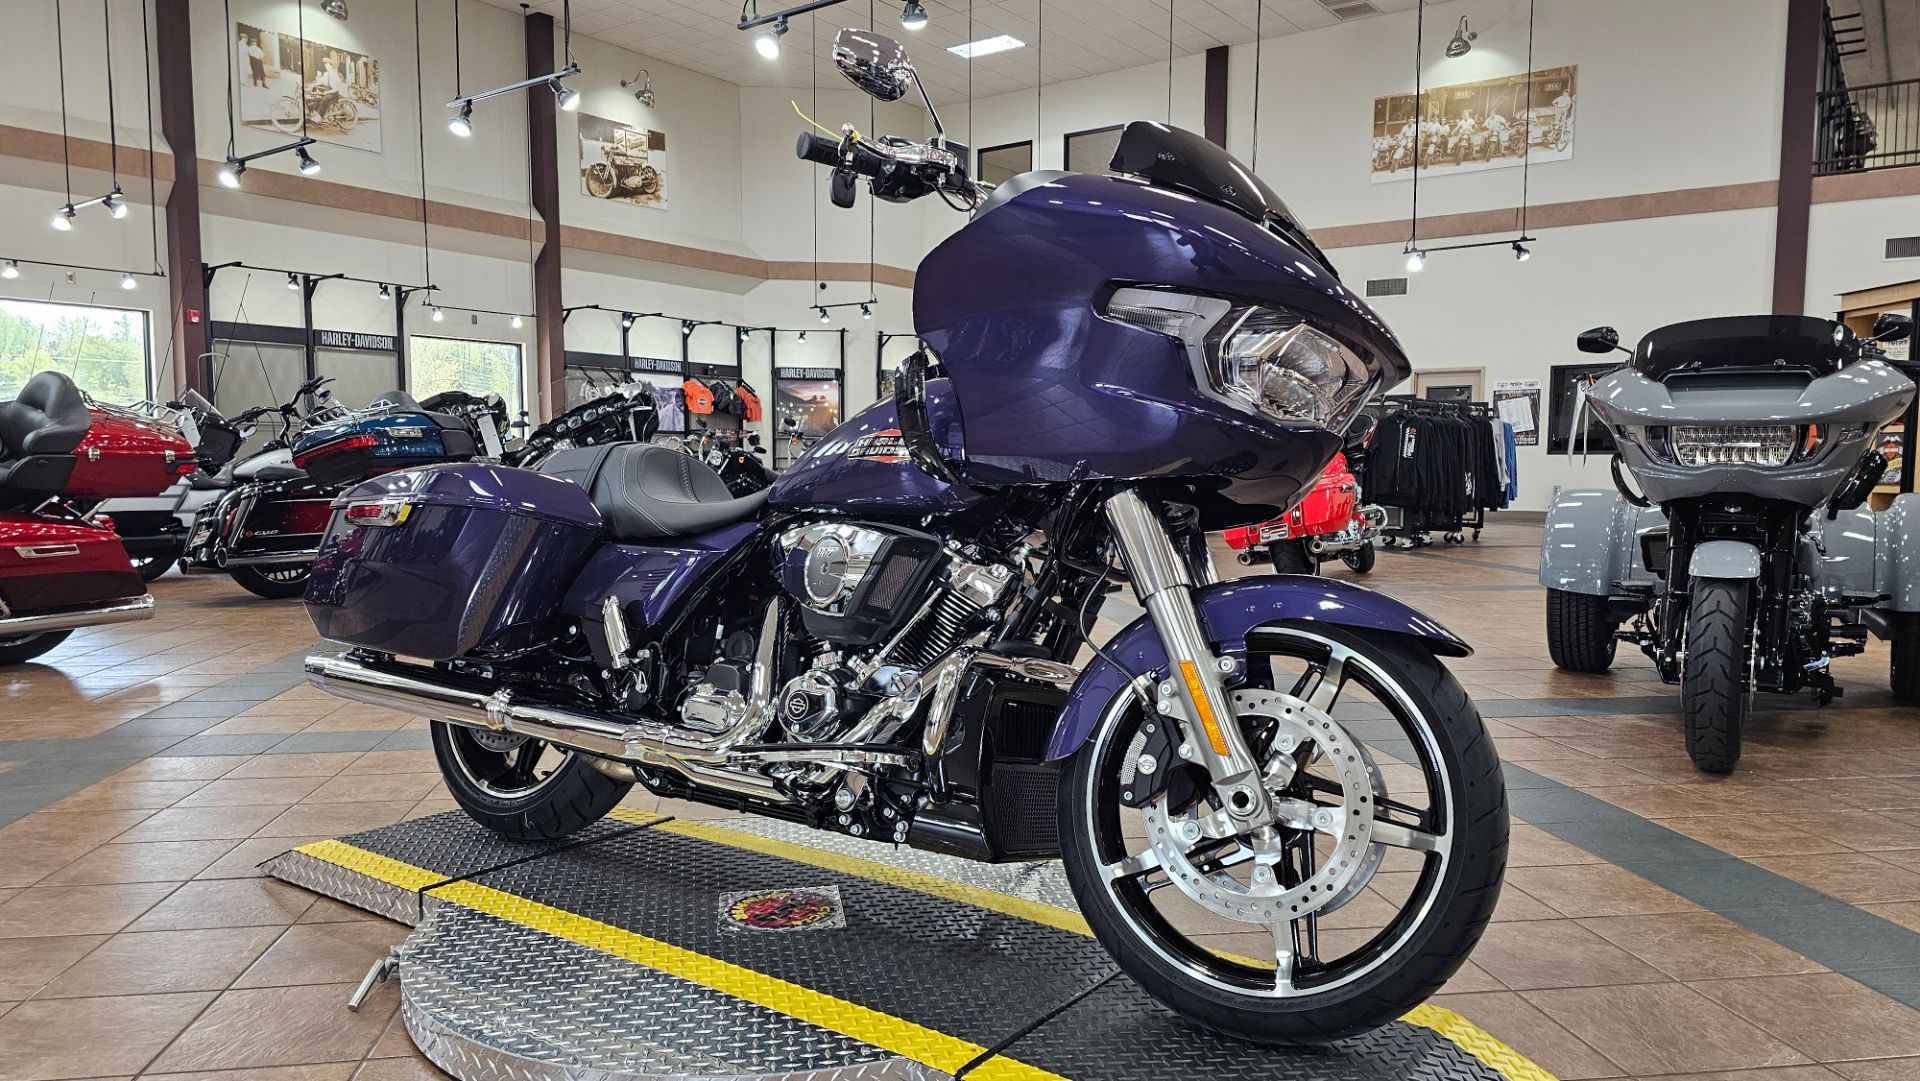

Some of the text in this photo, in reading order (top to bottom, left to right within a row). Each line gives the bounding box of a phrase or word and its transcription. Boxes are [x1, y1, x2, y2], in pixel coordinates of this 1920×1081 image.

[321, 331, 394, 350] HARLEY-DAVIDSON
[634, 357, 682, 372] HARLEY-DAVIDSON
[780, 368, 836, 379] HARLEY-DAVIDSON
[817, 546, 839, 558] 117
